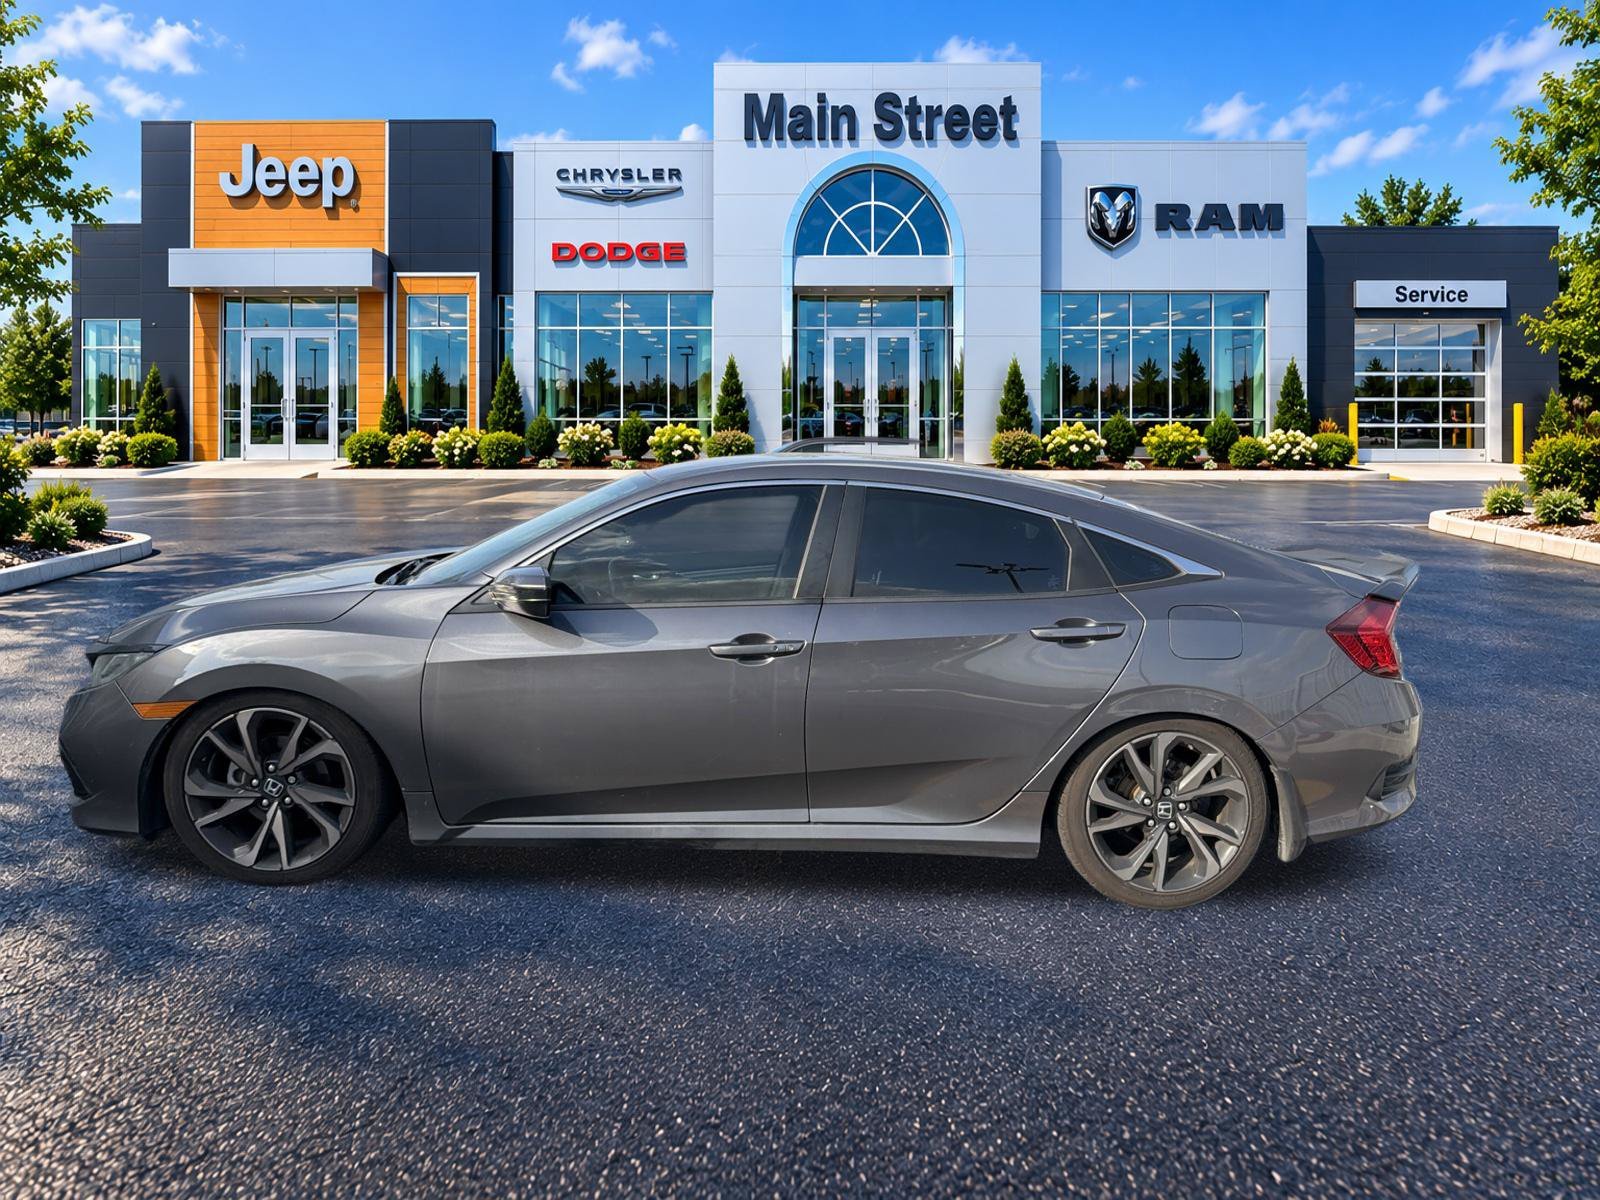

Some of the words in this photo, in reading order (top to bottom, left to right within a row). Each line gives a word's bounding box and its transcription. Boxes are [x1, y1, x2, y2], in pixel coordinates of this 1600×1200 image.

[744, 92, 857, 141] Main
[873, 91, 1018, 142] Street
[218, 143, 355, 209] Jeep
[556, 167, 683, 183] CHRYSLER
[1155, 203, 1284, 232] RAM
[551, 242, 687, 262] DODGE
[1395, 285, 1469, 303] Service
